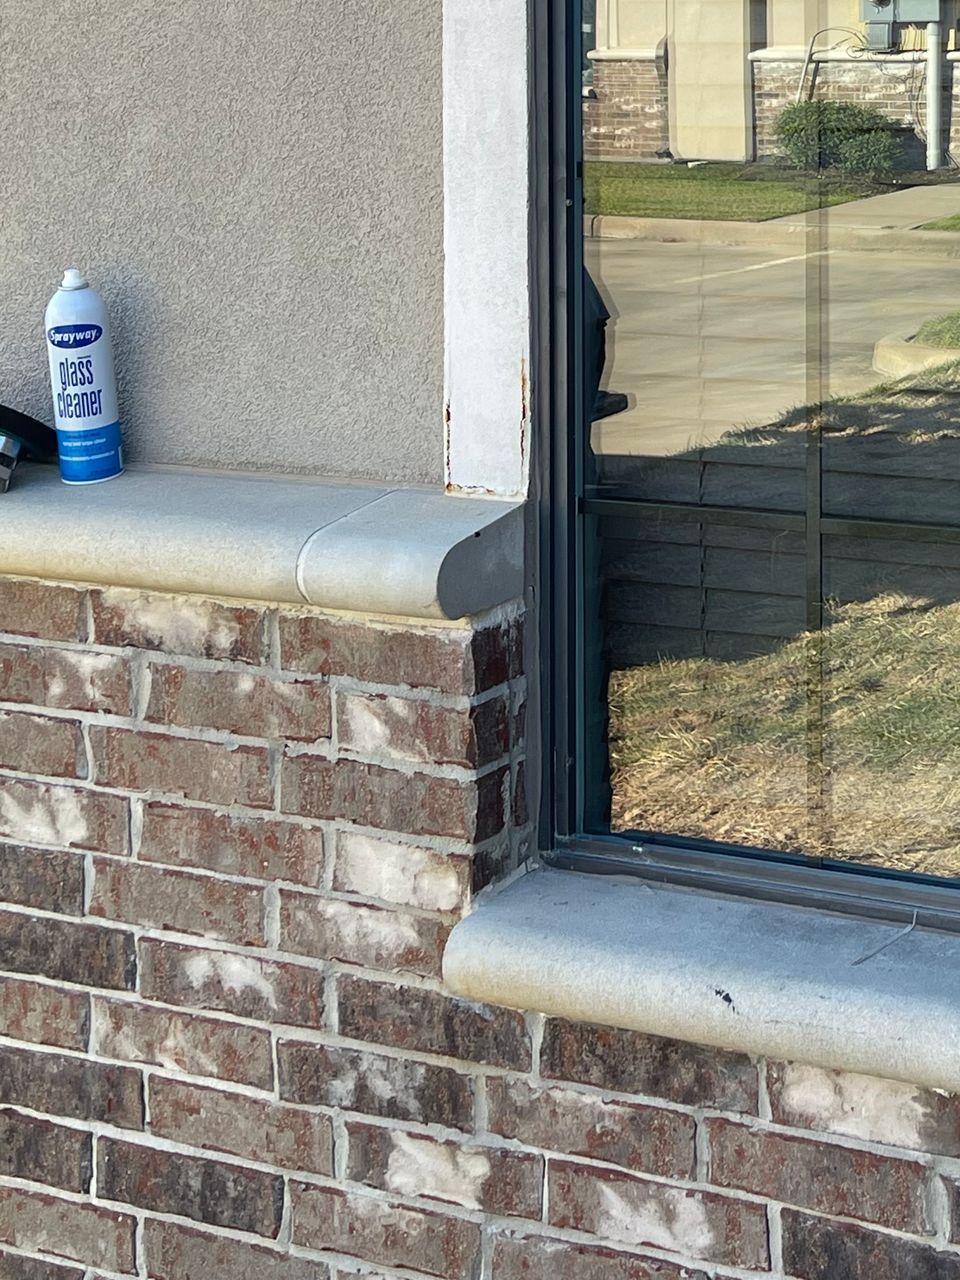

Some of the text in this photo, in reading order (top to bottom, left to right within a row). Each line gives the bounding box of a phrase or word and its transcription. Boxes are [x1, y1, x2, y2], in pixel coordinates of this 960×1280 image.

[50, 329, 98, 344] Sprayway
[59, 358, 94, 391] glass
[57, 388, 103, 419] cleaner
